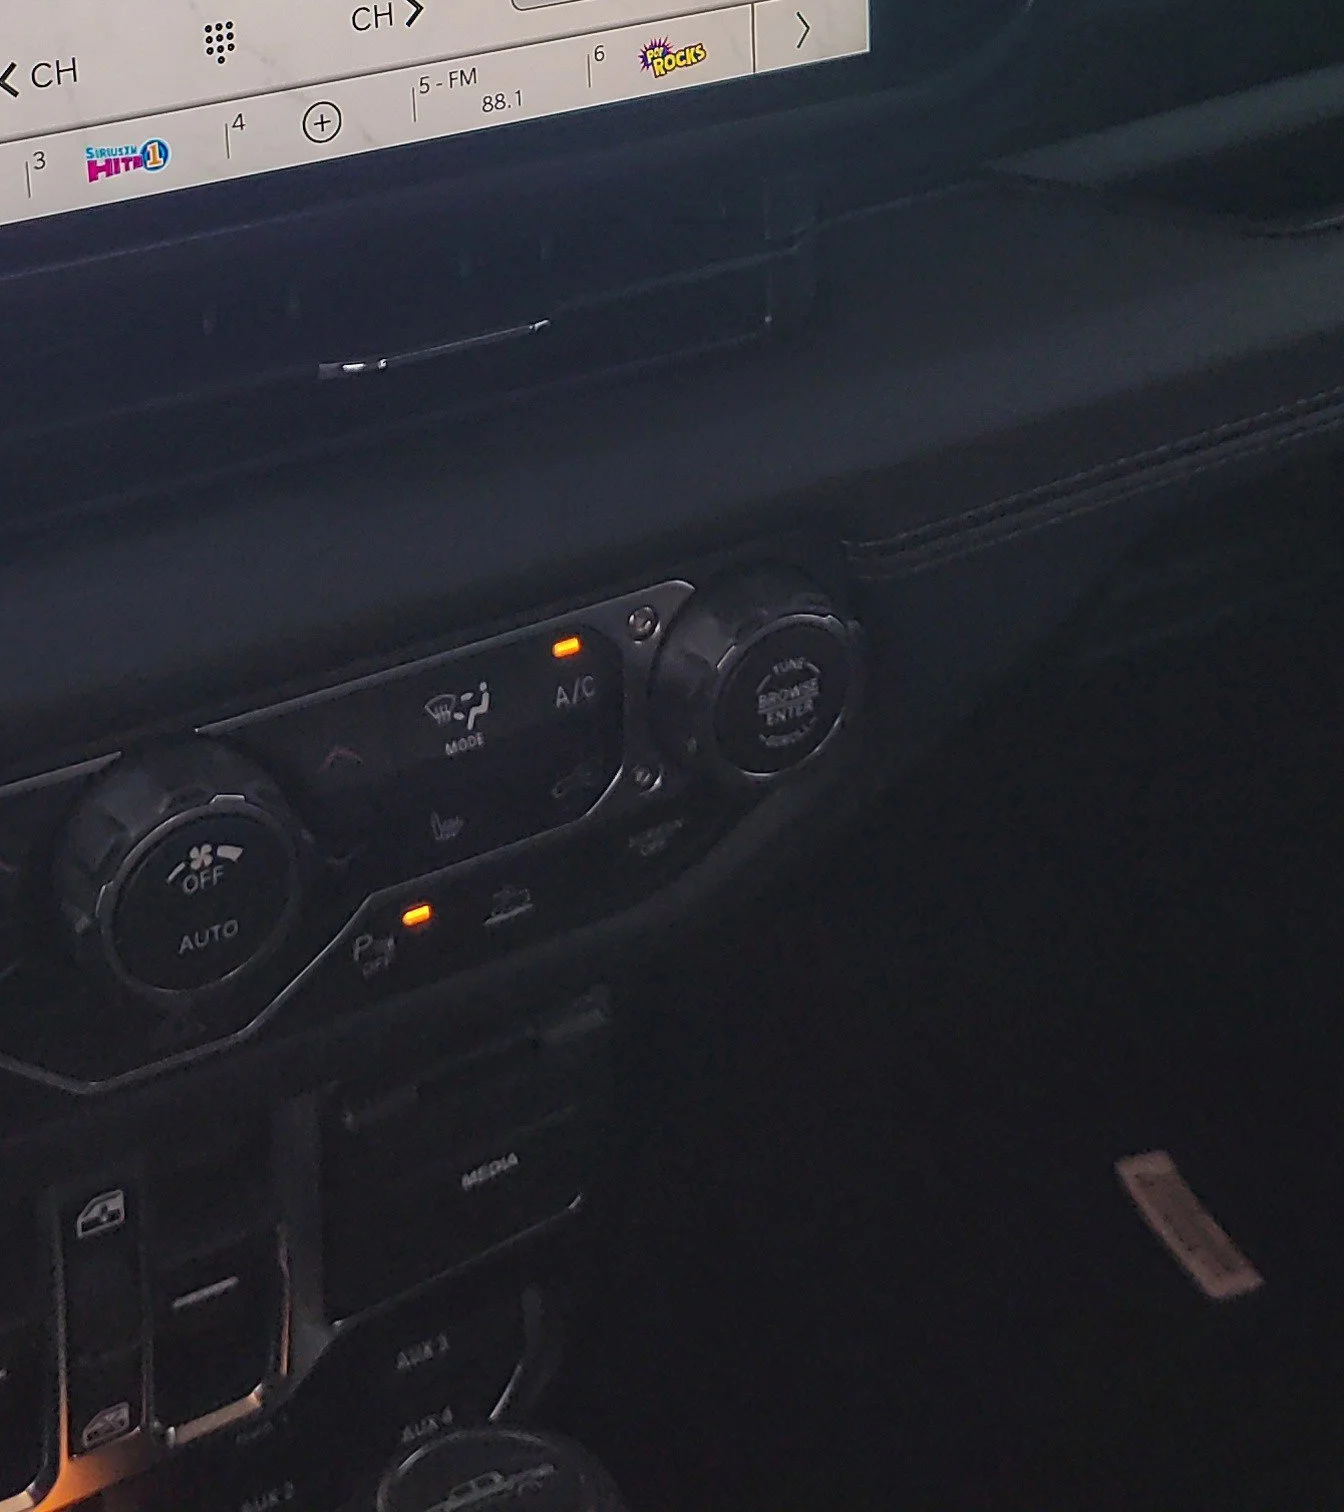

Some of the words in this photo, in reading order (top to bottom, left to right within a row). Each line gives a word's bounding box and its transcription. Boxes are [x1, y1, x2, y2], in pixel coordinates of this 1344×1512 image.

[351, 2, 394, 32] CH
[594, 45, 605, 61] 6
[652, 43, 707, 78] ROCKS
[30, 59, 78, 90] CH
[419, 75, 430, 93] 5
[448, 67, 478, 87] FM
[481, 90, 524, 113] 88.1
[231, 113, 246, 131] 4
[33, 151, 46, 170] 3
[553, 676, 596, 708] A/C
[444, 732, 487, 756] MODE
[181, 869, 224, 896] OFF
[176, 922, 240, 955] AUTO
[462, 1151, 518, 1189] MEDIA
